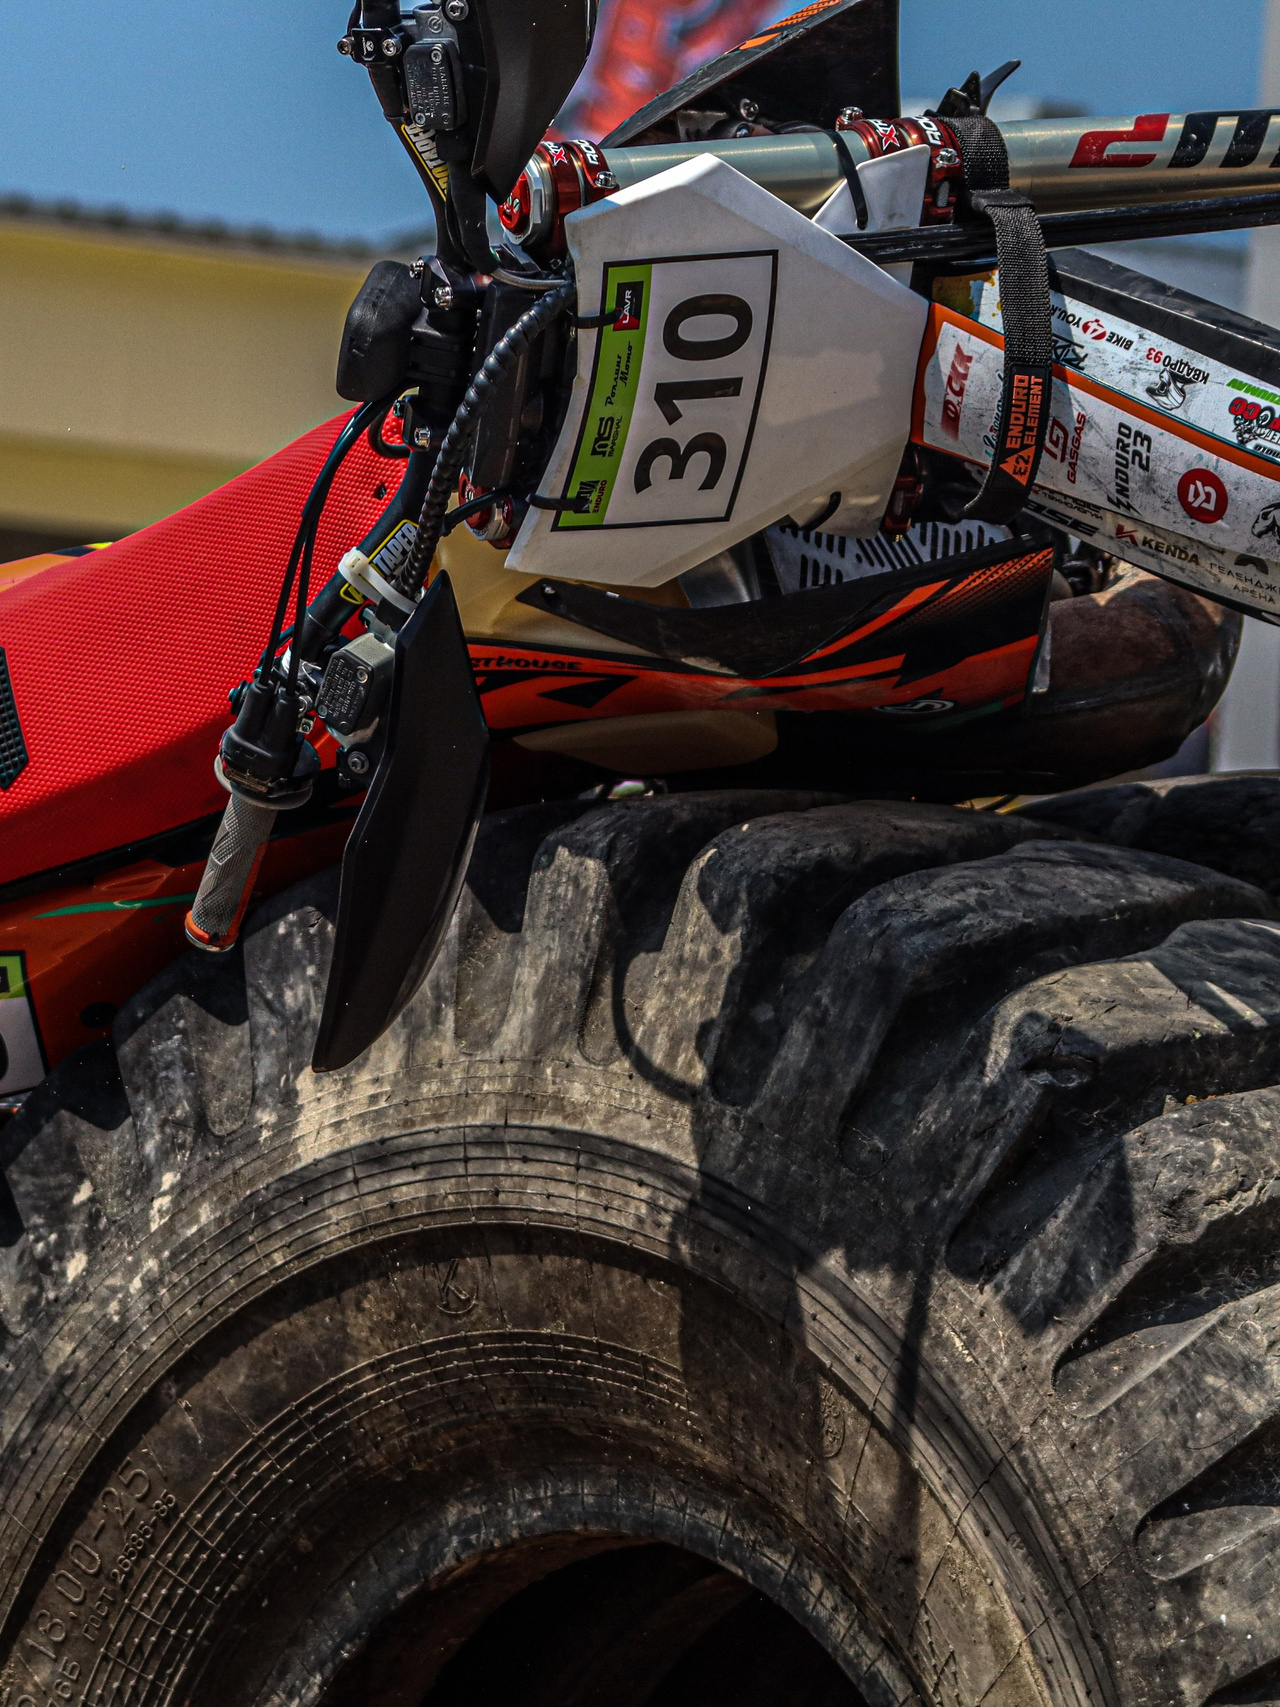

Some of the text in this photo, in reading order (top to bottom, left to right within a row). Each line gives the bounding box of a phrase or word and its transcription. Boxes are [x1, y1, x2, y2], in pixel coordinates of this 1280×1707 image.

[622, 289, 632, 324] LAVR
[1106, 331, 1134, 351] BIKE
[1146, 347, 1210, 384] КВАДРО 93
[634, 293, 754, 495] 310
[1005, 375, 1029, 449] ENDURO
[1024, 375, 1044, 445] ELEMENT
[608, 416, 623, 457] MARSHAL
[1067, 412, 1086, 484] GASGAS
[1131, 430, 1152, 472] 23
[1107, 421, 1142, 516] ENDURO
[592, 479, 608, 513] ENDURO
[1142, 536, 1201, 566] KENDA
[1209, 562, 1280, 594] ГЕЛЕНДЖ
[1233, 584, 1276, 605] АРЕНА
[470, 655, 583, 671] STHOUSE
[82, 1586, 114, 1642] ГОСТ
